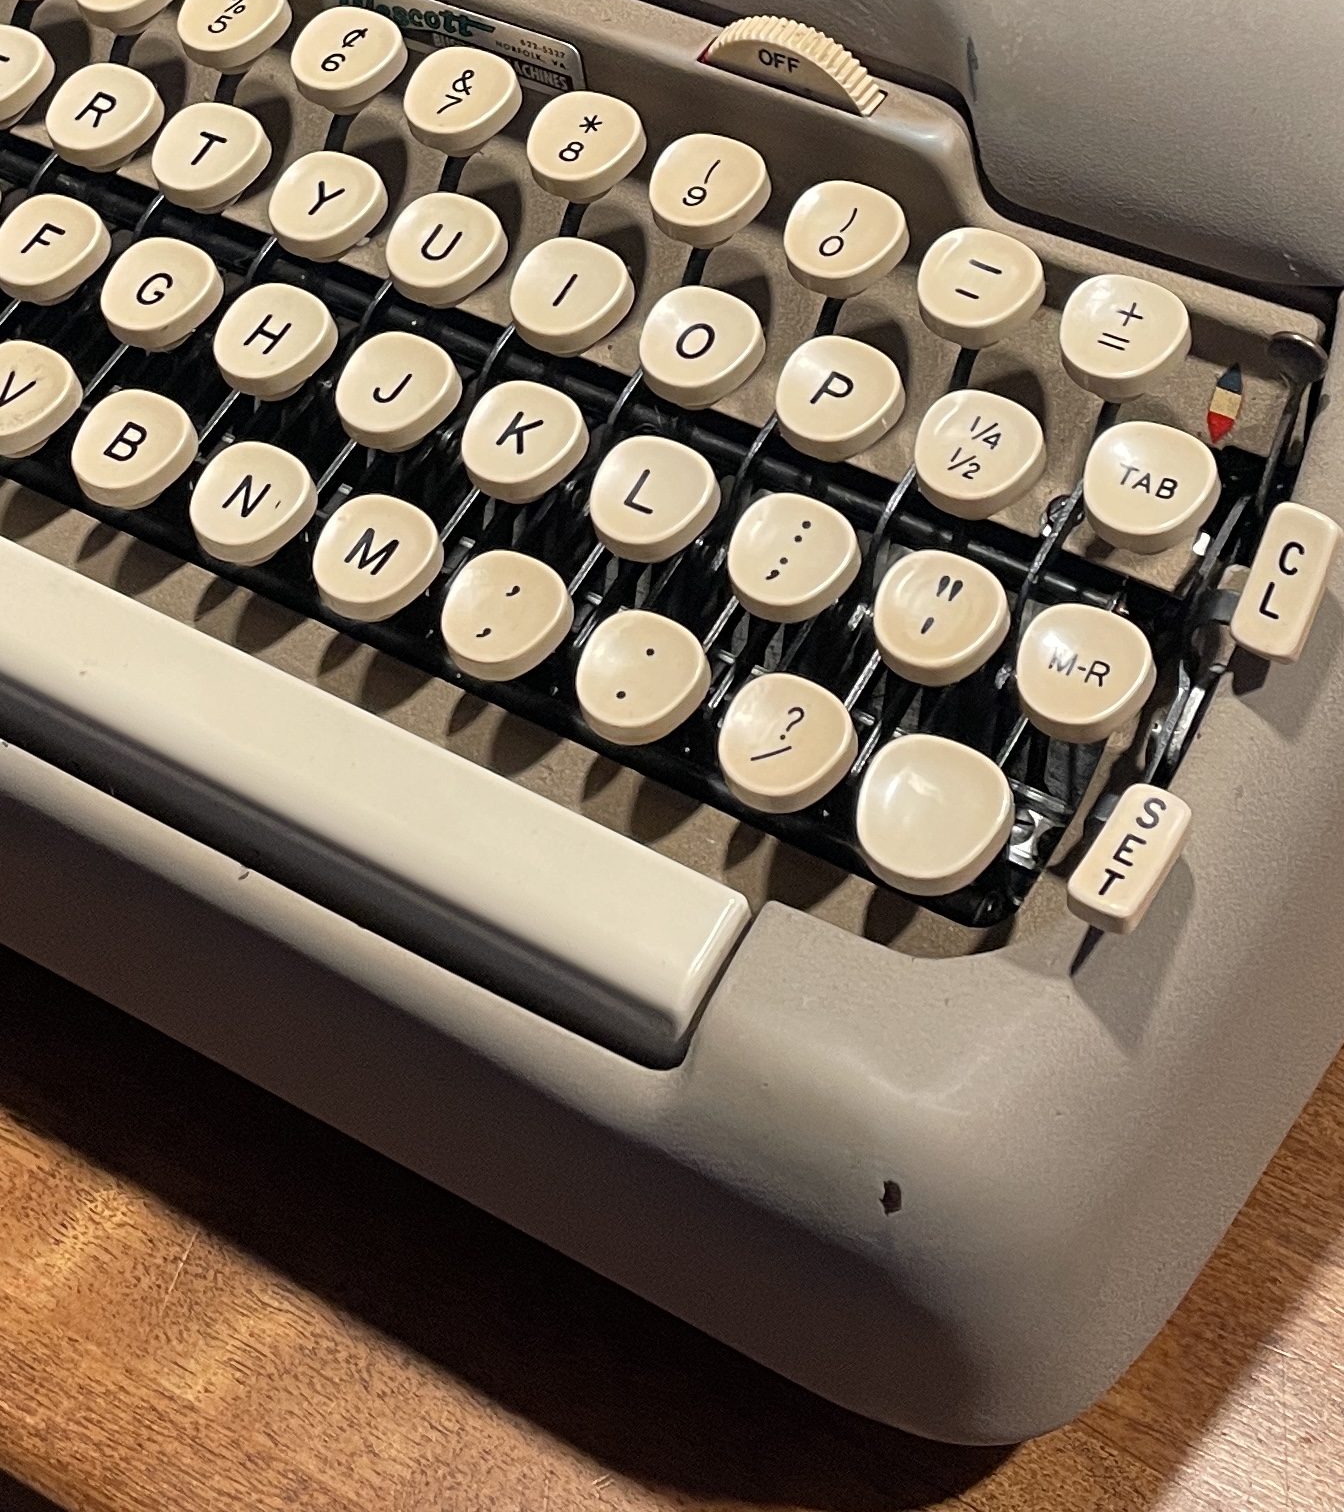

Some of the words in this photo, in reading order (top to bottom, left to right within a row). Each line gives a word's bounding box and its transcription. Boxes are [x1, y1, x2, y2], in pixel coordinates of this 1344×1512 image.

[208, 16, 234, 33] 5
[342, 28, 368, 48] ¢
[321, 54, 346, 71] 6
[506, 57, 568, 90] ACHINES
[759, 48, 800, 73] OFF
[452, 70, 475, 95] &
[75, 92, 117, 127] R
[437, 94, 463, 114] 7
[191, 131, 228, 166] T
[559, 142, 584, 161] 8
[308, 181, 345, 215] Y
[683, 187, 706, 206] 9
[20, 223, 65, 254] F
[421, 224, 463, 260] U
[819, 236, 844, 256] 0
[136, 273, 173, 305] G
[553, 274, 578, 306] I
[1117, 303, 1143, 326] +
[243, 314, 292, 354] H
[676, 323, 715, 359] O
[1098, 332, 1130, 351] =
[373, 373, 412, 403] J
[810, 371, 854, 404] P
[103, 421, 147, 461] B
[496, 412, 544, 454] K
[222, 475, 271, 517] N
[624, 469, 653, 514] L
[1120, 463, 1178, 499] TAB
[344, 528, 398, 575] M
[1048, 648, 1111, 688] M-R
[780, 707, 804, 740] ?
